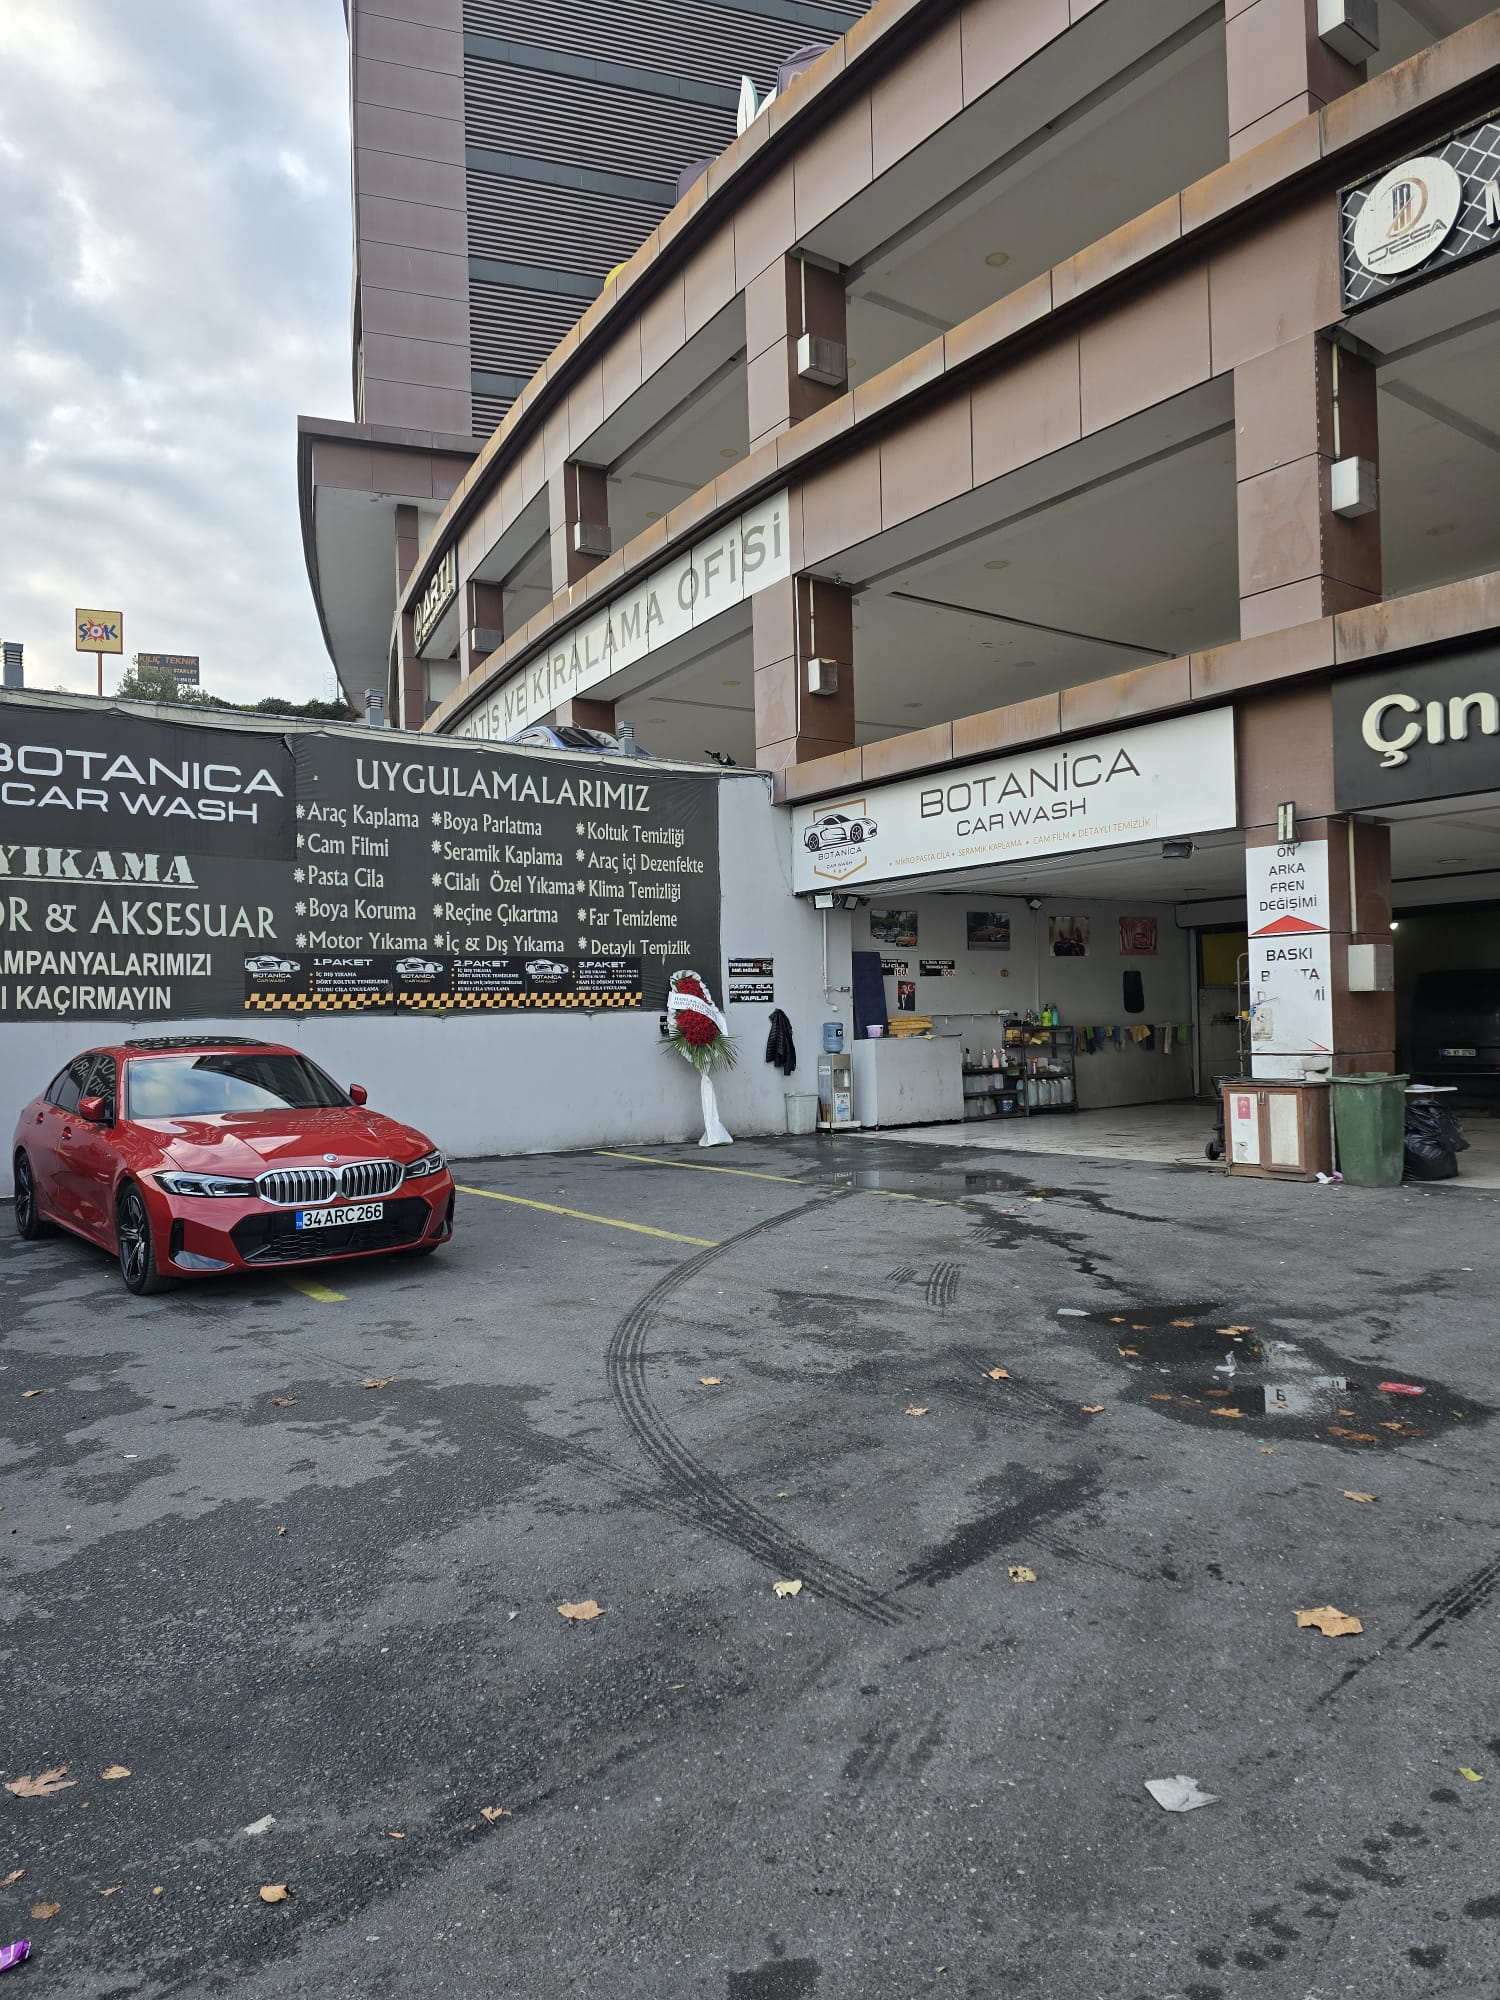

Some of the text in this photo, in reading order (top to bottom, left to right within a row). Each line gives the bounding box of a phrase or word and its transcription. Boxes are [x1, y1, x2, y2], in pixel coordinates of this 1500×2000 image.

[505, 680, 526, 722] VE
[533, 590, 664, 704] KİRALAMA
[678, 512, 781, 611] OFİSİ
[79, 623, 119, 642] ŞOK
[165, 656, 198, 666] TEKNİK
[1361, 691, 1500, 768] Çın
[356, 759, 650, 812] UYGULAMALARIMIZ
[921, 748, 1141, 819] BOTANİCA
[1, 782, 258, 824] CAR WASH
[306, 801, 420, 829] Araç Kaplama
[443, 811, 542, 836] Boya Parlatma
[956, 797, 1087, 836] CAR WASH
[307, 833, 389, 857] Cam Filmi
[587, 821, 685, 848] Koltuk Temizliği
[915, 854, 936, 864] PASTA
[988, 840, 1022, 853] KAPLAMA
[1033, 835, 1050, 845] CAM
[1052, 831, 1070, 841] FİLM
[1078, 826, 1111, 838] DETAYLI
[1113, 817, 1151, 832] TEMİZLİK
[443, 841, 563, 868] Seramik Kaplama
[587, 850, 704, 875] Araç içi Dezenfekte
[818, 847, 863, 861] BOTANİCA
[308, 865, 384, 888] Pasta Cila
[1268, 862, 1306, 877] ARKA
[444, 870, 576, 895] Cilalı Özel Yıkama
[588, 879, 681, 903] Klima Temizliği
[1270, 880, 1305, 893] FREN
[308, 896, 417, 921] Boya Koruma
[445, 902, 559, 926] Reçine Çıkartma
[1259, 894, 1317, 912] DEĞİŞİMİ
[45, 903, 78, 933] &
[89, 899, 278, 938] AKSESUAR
[589, 907, 678, 927] Far Temizleme
[308, 930, 428, 951] Motor Yıkama
[445, 930, 565, 956] İç & Dış Yıkama
[591, 939, 691, 958] Detaylı Temizlik
[0, 950, 212, 976] MPANYALARIMIZI
[1266, 947, 1313, 961] BASKI
[16, 985, 171, 1016] KAÇIRMAYIN
[304, 1204, 382, 1227] 34 ARC 266
